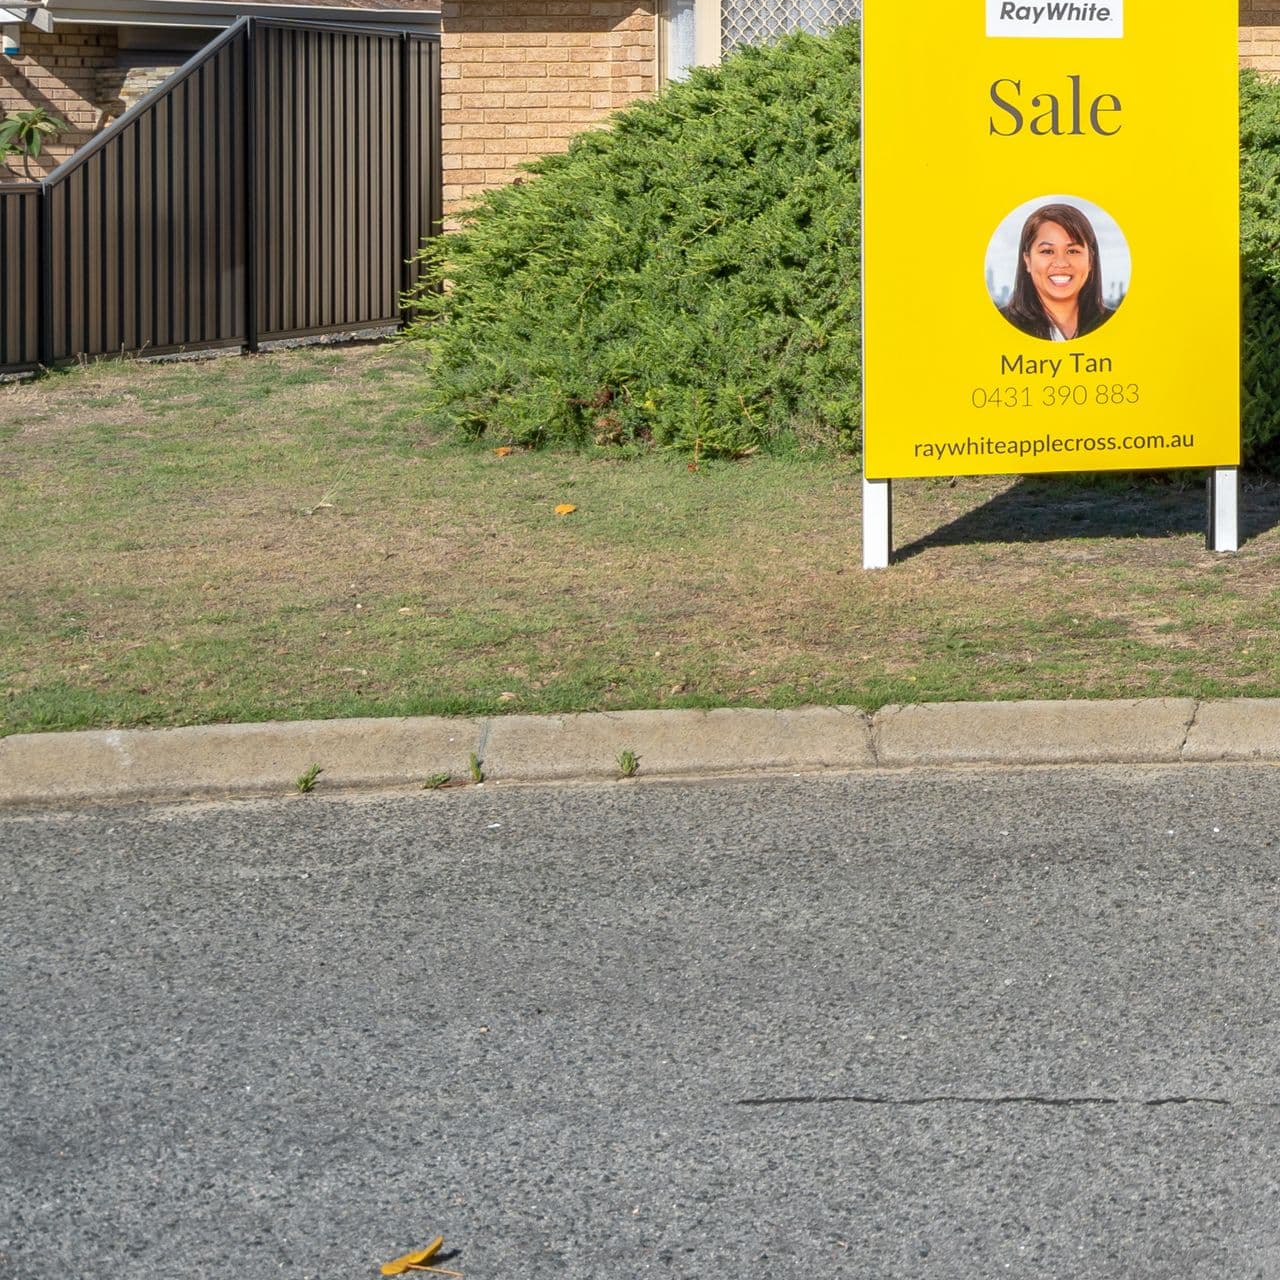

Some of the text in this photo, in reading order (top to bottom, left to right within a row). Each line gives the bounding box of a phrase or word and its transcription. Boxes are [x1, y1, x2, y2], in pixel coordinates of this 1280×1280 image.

[989, 74, 1122, 137] Sale
[1001, 353, 1112, 379] Mary Tan
[971, 383, 1140, 409] 0431 390 883
[914, 433, 1194, 461] raywhiteapplecross.com.au
